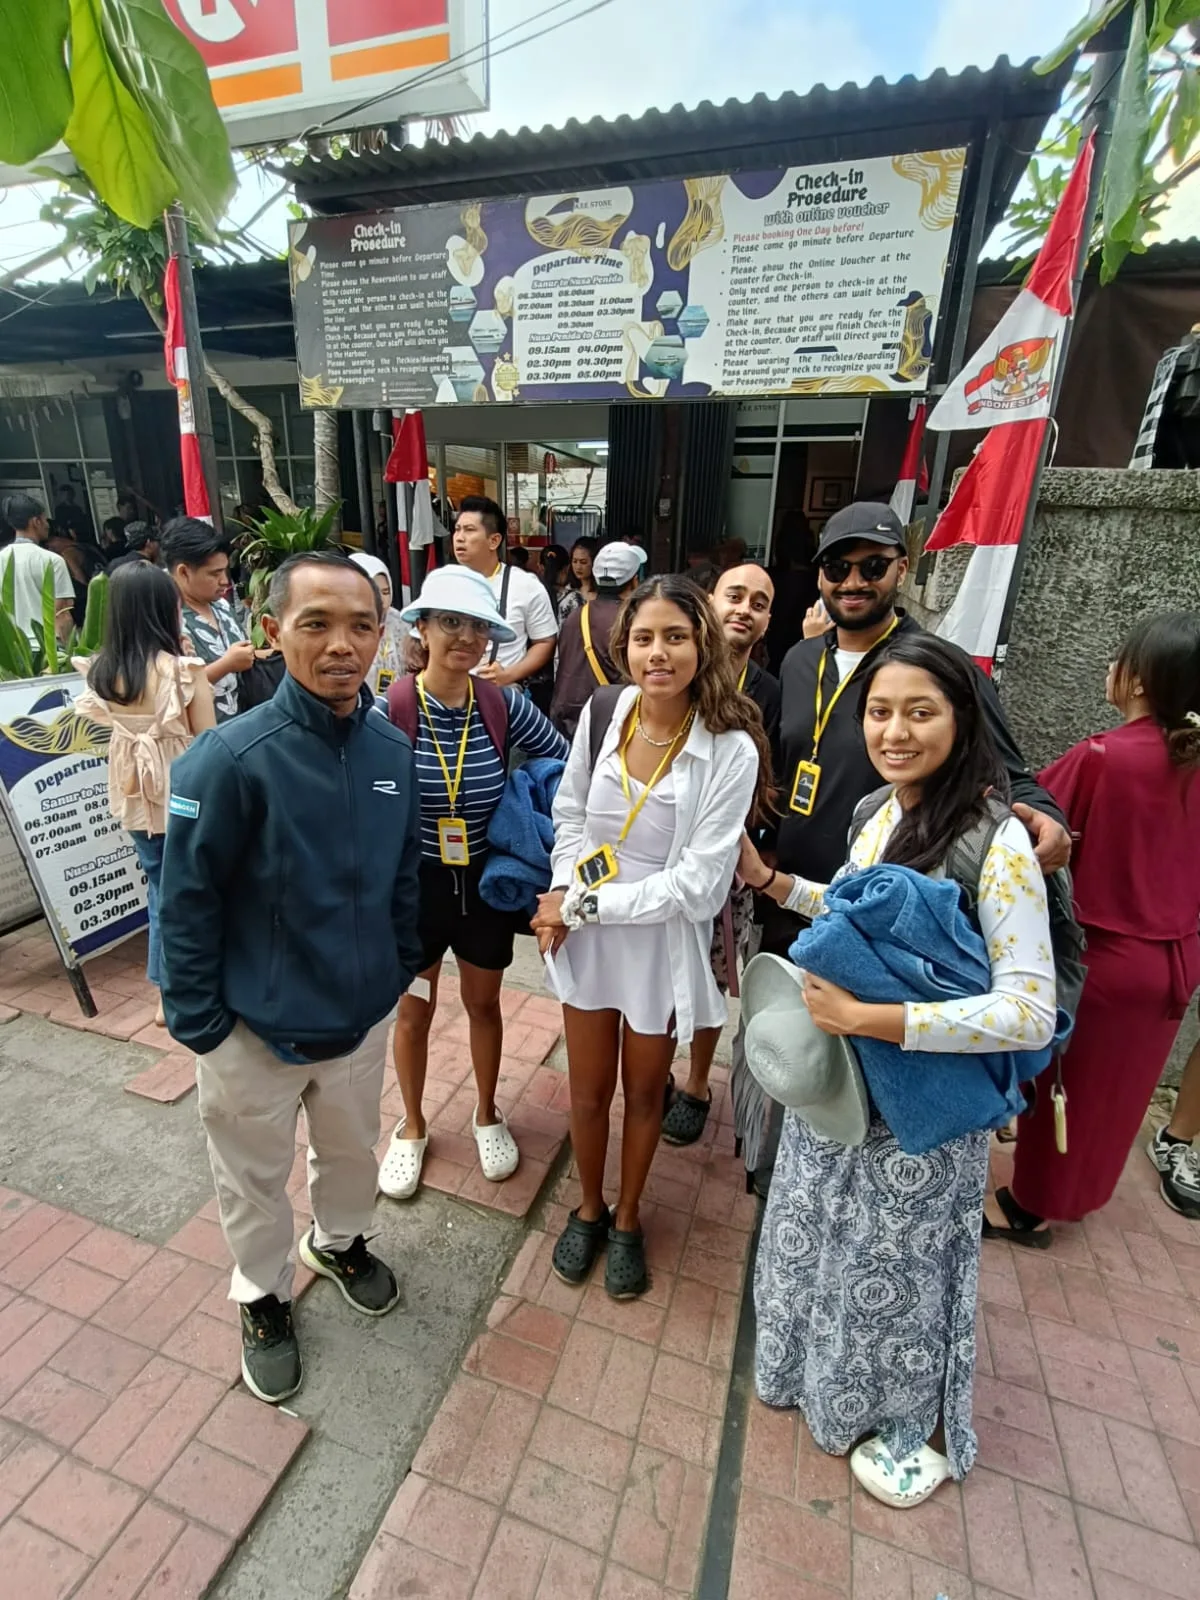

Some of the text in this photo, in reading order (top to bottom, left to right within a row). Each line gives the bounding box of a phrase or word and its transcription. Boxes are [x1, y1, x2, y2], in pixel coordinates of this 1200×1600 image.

[795, 169, 864, 190] Check-in
[787, 186, 868, 208] Prosedure
[764, 202, 890, 226] with online voucher
[354, 221, 401, 238] Check-in
[734, 222, 864, 242] Please booking One Day before!
[351, 235, 406, 252] Prosedure
[732, 241, 759, 253] Please
[763, 240, 784, 250] come
[802, 236, 832, 247] minute
[836, 234, 864, 244] before
[869, 229, 914, 243] Departure
[533, 255, 623, 276] Departure Time
[731, 252, 911, 275] Please show the Online Voucher at the
[531, 274, 623, 289] Sanur to Nusa Penida
[729, 274, 907, 298] Only need one person to check-in at the
[730, 274, 759, 285] counter
[762, 274, 774, 283] for
[764, 294, 779, 304] and
[784, 293, 797, 302] the
[801, 291, 828, 301] others
[833, 290, 847, 298] can
[852, 287, 871, 297] wait
[876, 284, 906, 295] behind
[726, 307, 902, 327] Make sure that you are ready for the
[727, 306, 740, 316] the
[528, 334, 552, 342] Nusa
[552, 332, 580, 341] Penida
[594, 330, 624, 339] Sanur
[764, 324, 796, 335] Because
[798, 323, 817, 332] once
[819, 322, 834, 332] you
[836, 319, 861, 330] finish
[863, 317, 900, 329] Check-in
[725, 339, 733, 347] at
[735, 337, 748, 346] the
[785, 334, 800, 343] Our
[802, 330, 823, 342] staff
[825, 331, 841, 341] will
[844, 329, 870, 340] Direct
[872, 328, 887, 340] you
[890, 328, 899, 337] to
[528, 344, 623, 354] 09.15am 04.00pm
[724, 347, 737, 356] the
[527, 358, 622, 368] 02.30pm 04.30pm
[722, 360, 894, 376] Pass around your neck to recognize you as
[723, 357, 748, 366] Please
[757, 355, 790, 366] wearing
[799, 353, 812, 363] the
[527, 370, 621, 381] 03.30pm 05.00pm
[722, 376, 734, 386] our
[978, 395, 1039, 409] INDONESIA
[41, 791, 81, 811] Sanur
[81, 786, 94, 799] to
[24, 808, 77, 831] 06.30am
[30, 821, 82, 845] 07.00am
[35, 834, 87, 859] 07.30am
[64, 859, 97, 881] Nusa
[97, 845, 136, 869] Penida
[69, 865, 127, 897] 09.15am
[74, 881, 134, 915] 02.30pm
[80, 897, 140, 931] 03.30pm
